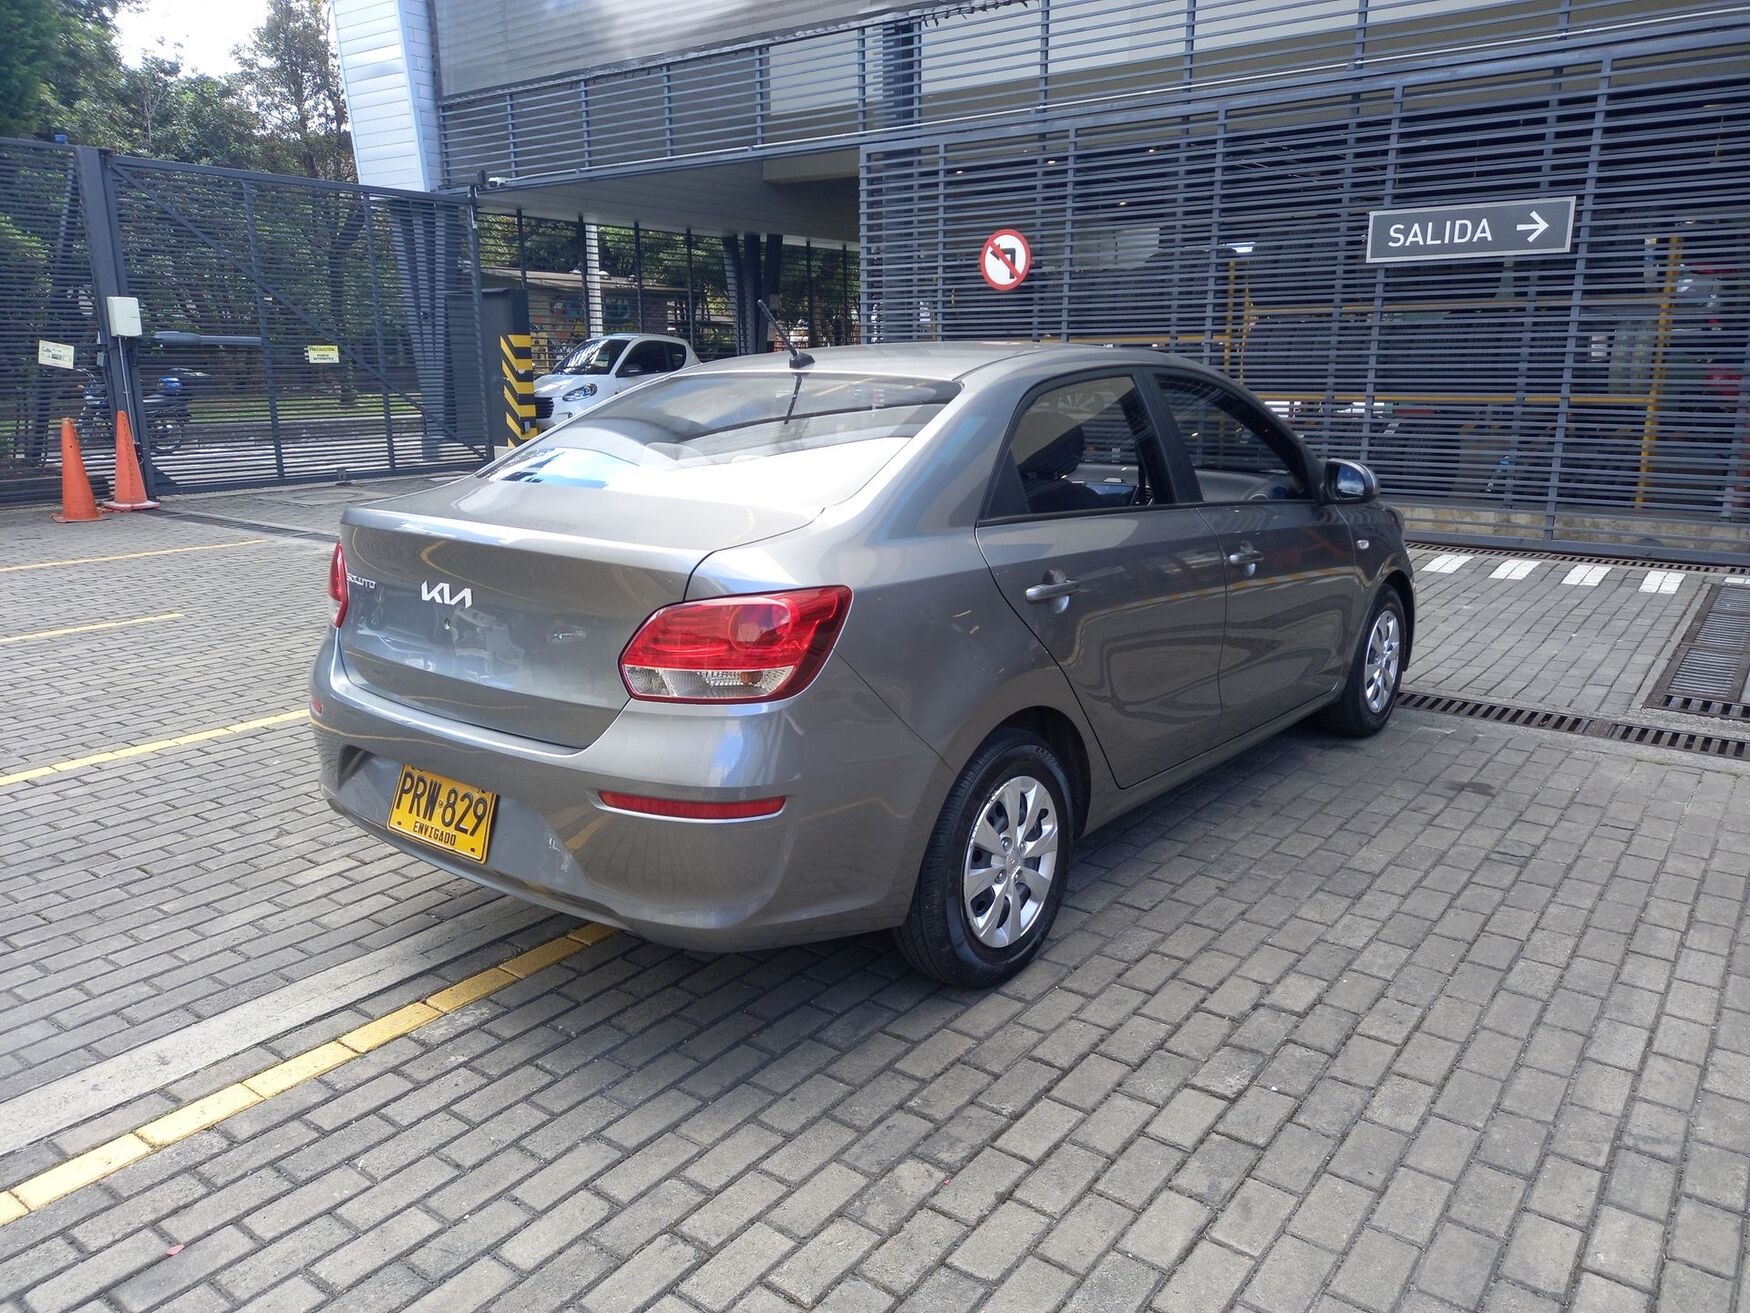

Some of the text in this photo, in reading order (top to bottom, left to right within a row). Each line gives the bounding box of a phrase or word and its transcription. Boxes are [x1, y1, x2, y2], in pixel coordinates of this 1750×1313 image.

[1388, 218, 1493, 247] SALIDA
[421, 580, 472, 608] KIA
[413, 820, 457, 846] ENVIGADO
